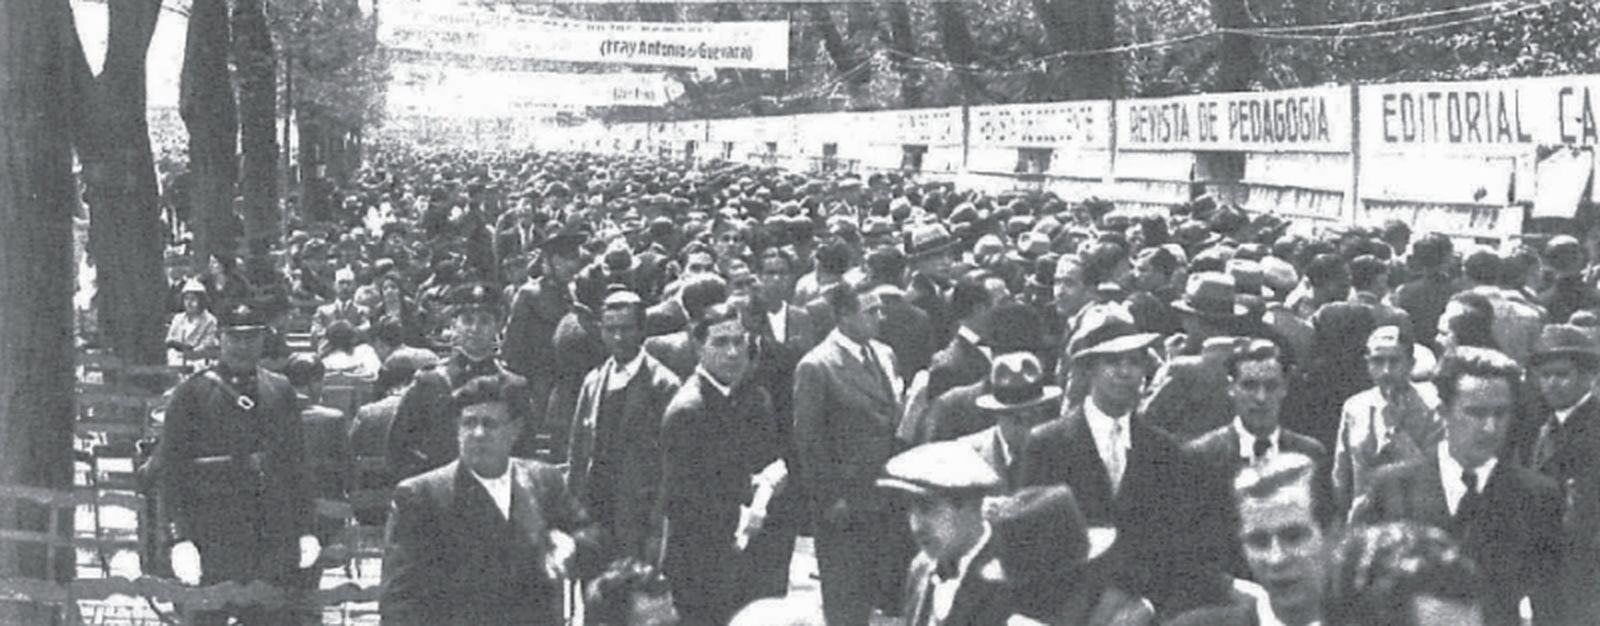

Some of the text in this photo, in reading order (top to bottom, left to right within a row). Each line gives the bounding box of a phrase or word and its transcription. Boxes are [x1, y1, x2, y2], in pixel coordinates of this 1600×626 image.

[1130, 102, 1190, 143] REVISTA
[1199, 101, 1219, 143] DE
[1229, 97, 1330, 143] PEDAGOGIA
[1383, 90, 1532, 143] EDITORIAL
